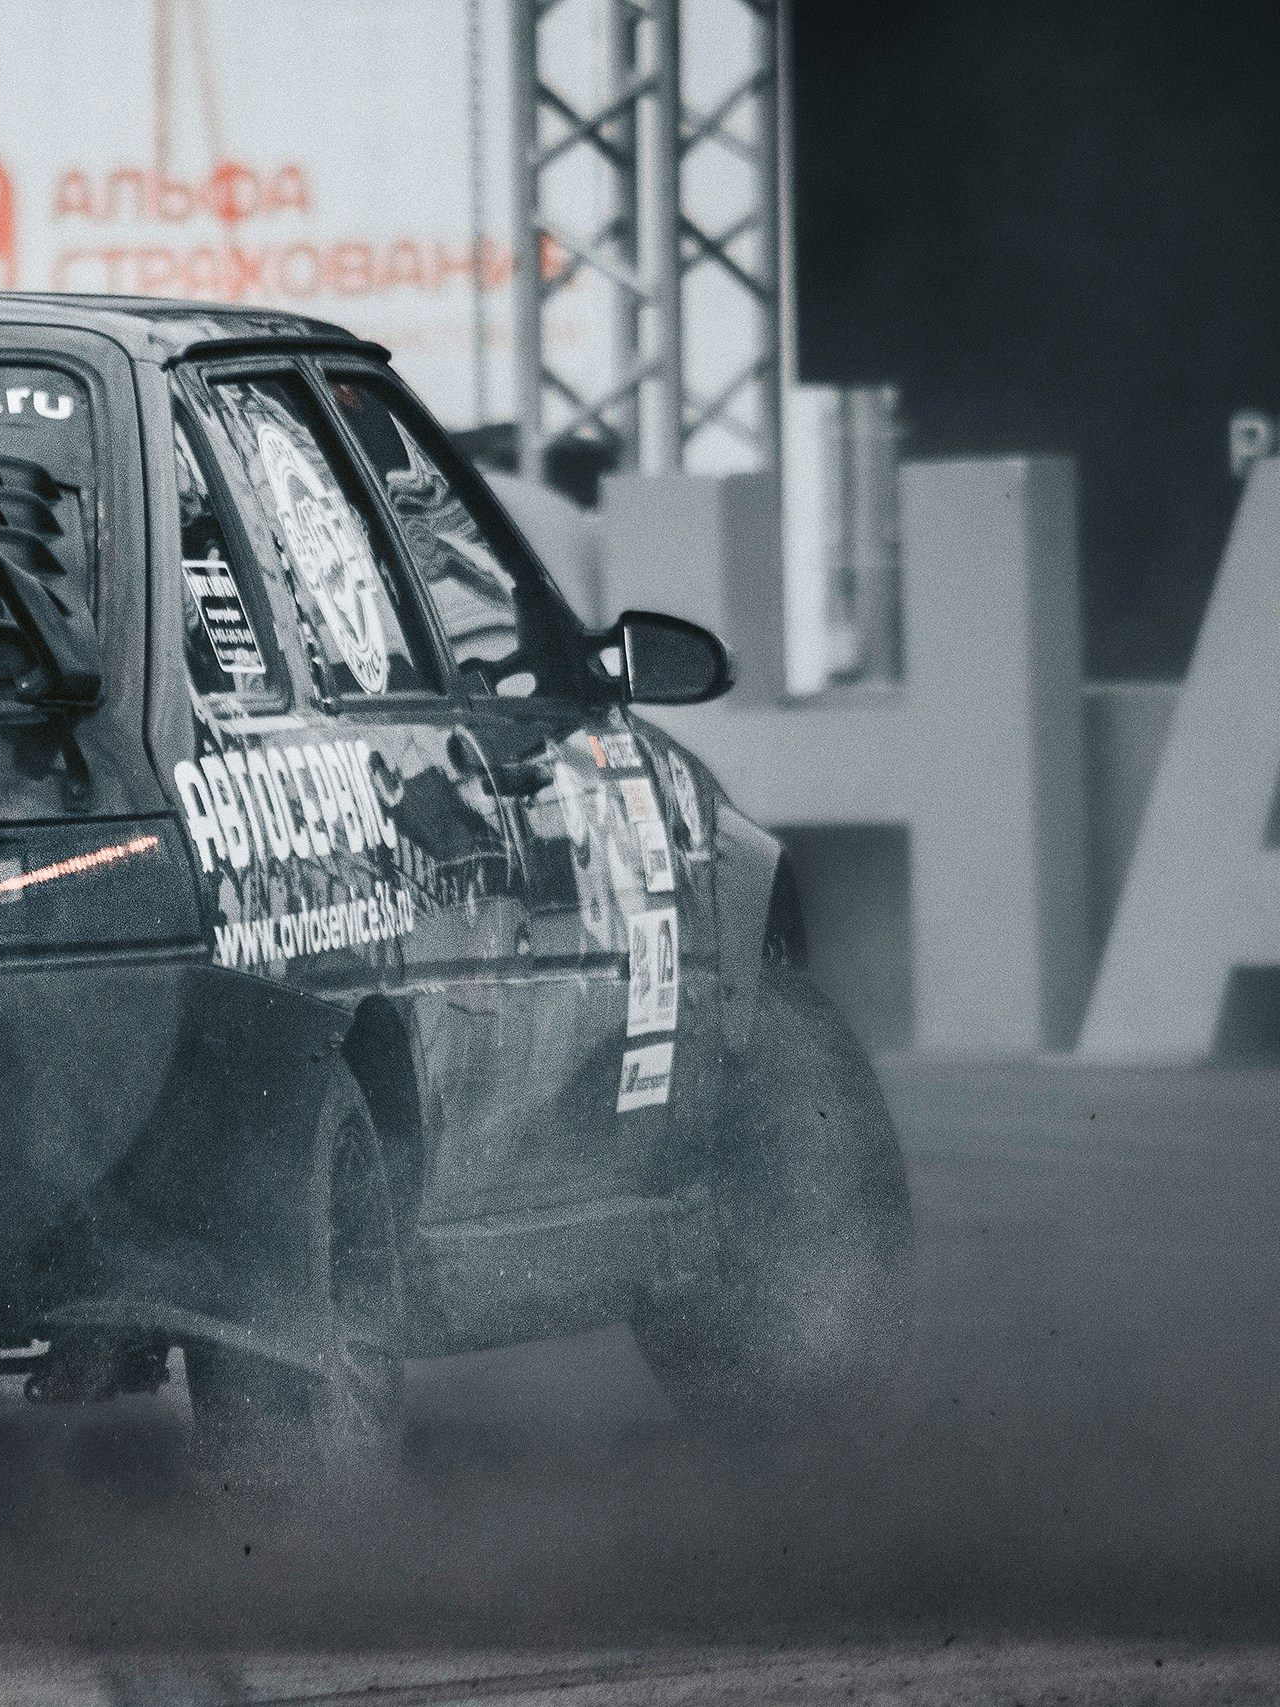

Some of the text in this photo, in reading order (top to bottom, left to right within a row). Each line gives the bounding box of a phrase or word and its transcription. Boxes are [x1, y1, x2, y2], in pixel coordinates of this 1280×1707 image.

[53, 162, 312, 224] АЛЬФА
[173, 739, 399, 873] АВТОСЕРВИС
[213, 880, 415, 967] www.avtoservice36.ru
